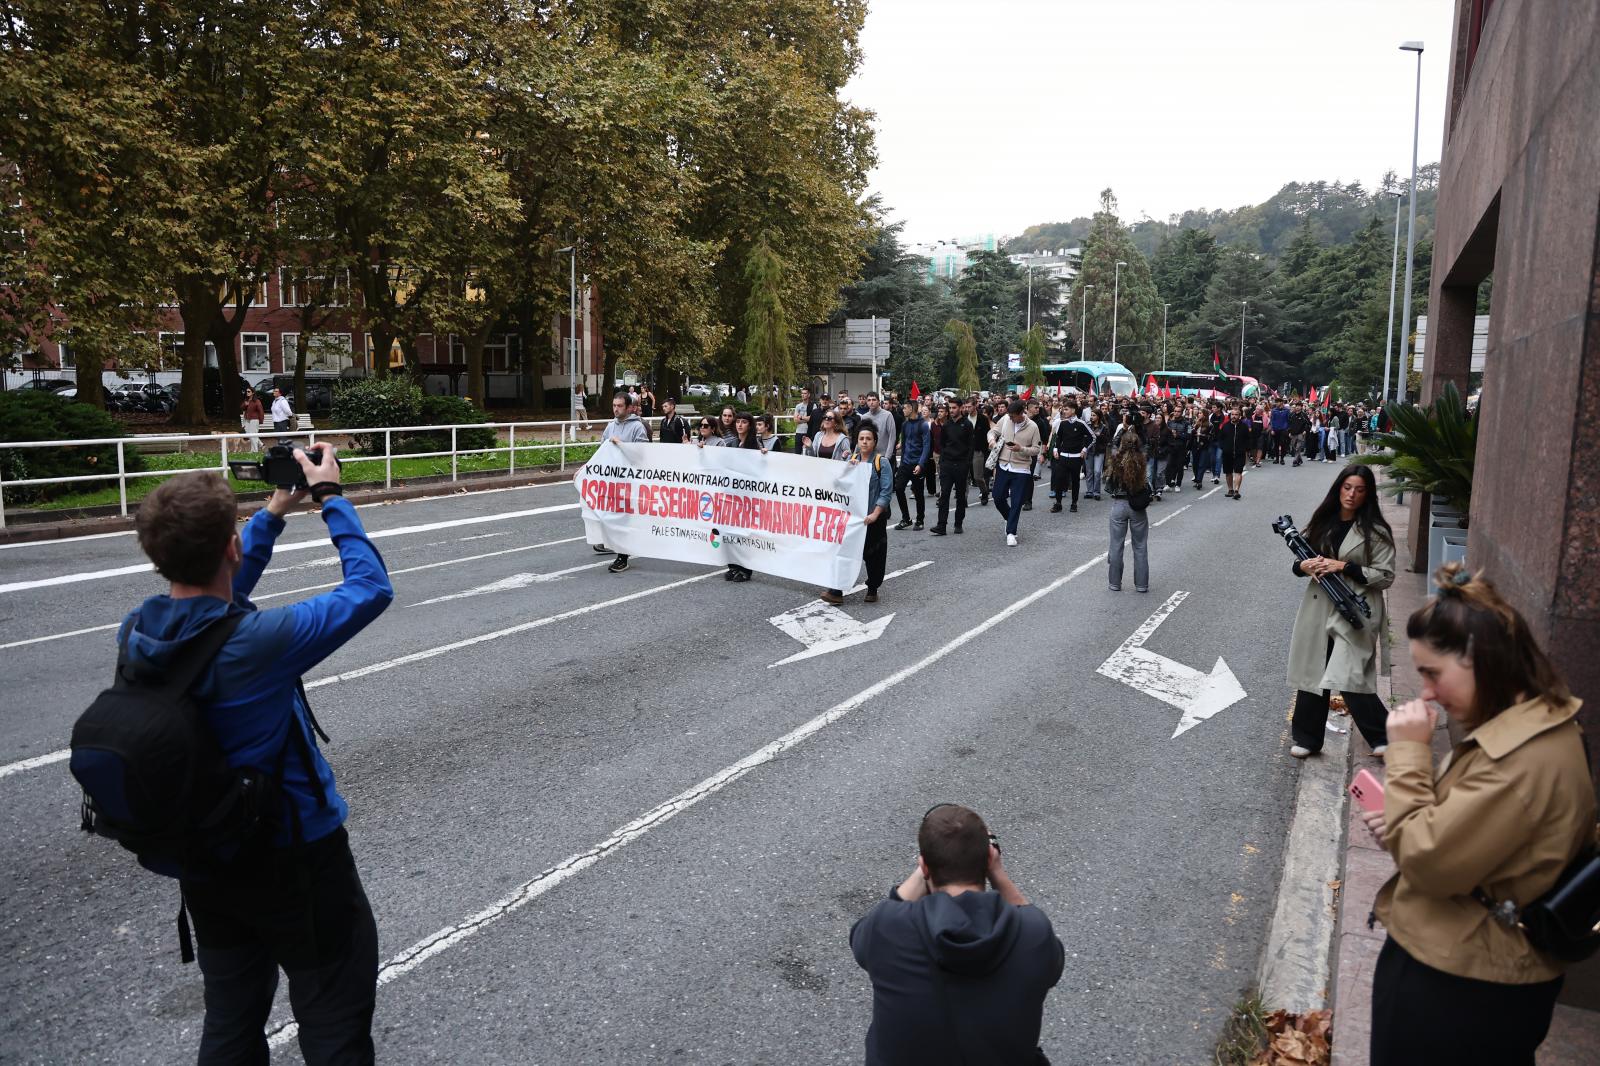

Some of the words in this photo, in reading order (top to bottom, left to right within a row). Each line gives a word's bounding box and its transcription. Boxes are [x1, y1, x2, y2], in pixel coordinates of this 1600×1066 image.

[682, 472, 730, 488] KONTRAKO
[732, 478, 778, 495] BORROKA
[782, 485, 796, 497] EZ
[798, 486, 812, 499] DA
[814, 488, 850, 506] BUKATU
[581, 478, 634, 514] ISRAEL
[638, 484, 699, 520] DESEGIN
[713, 492, 814, 539] HARREMANAK
[813, 505, 852, 544] ETEN
[651, 525, 708, 543] PALESTINAREKIN
